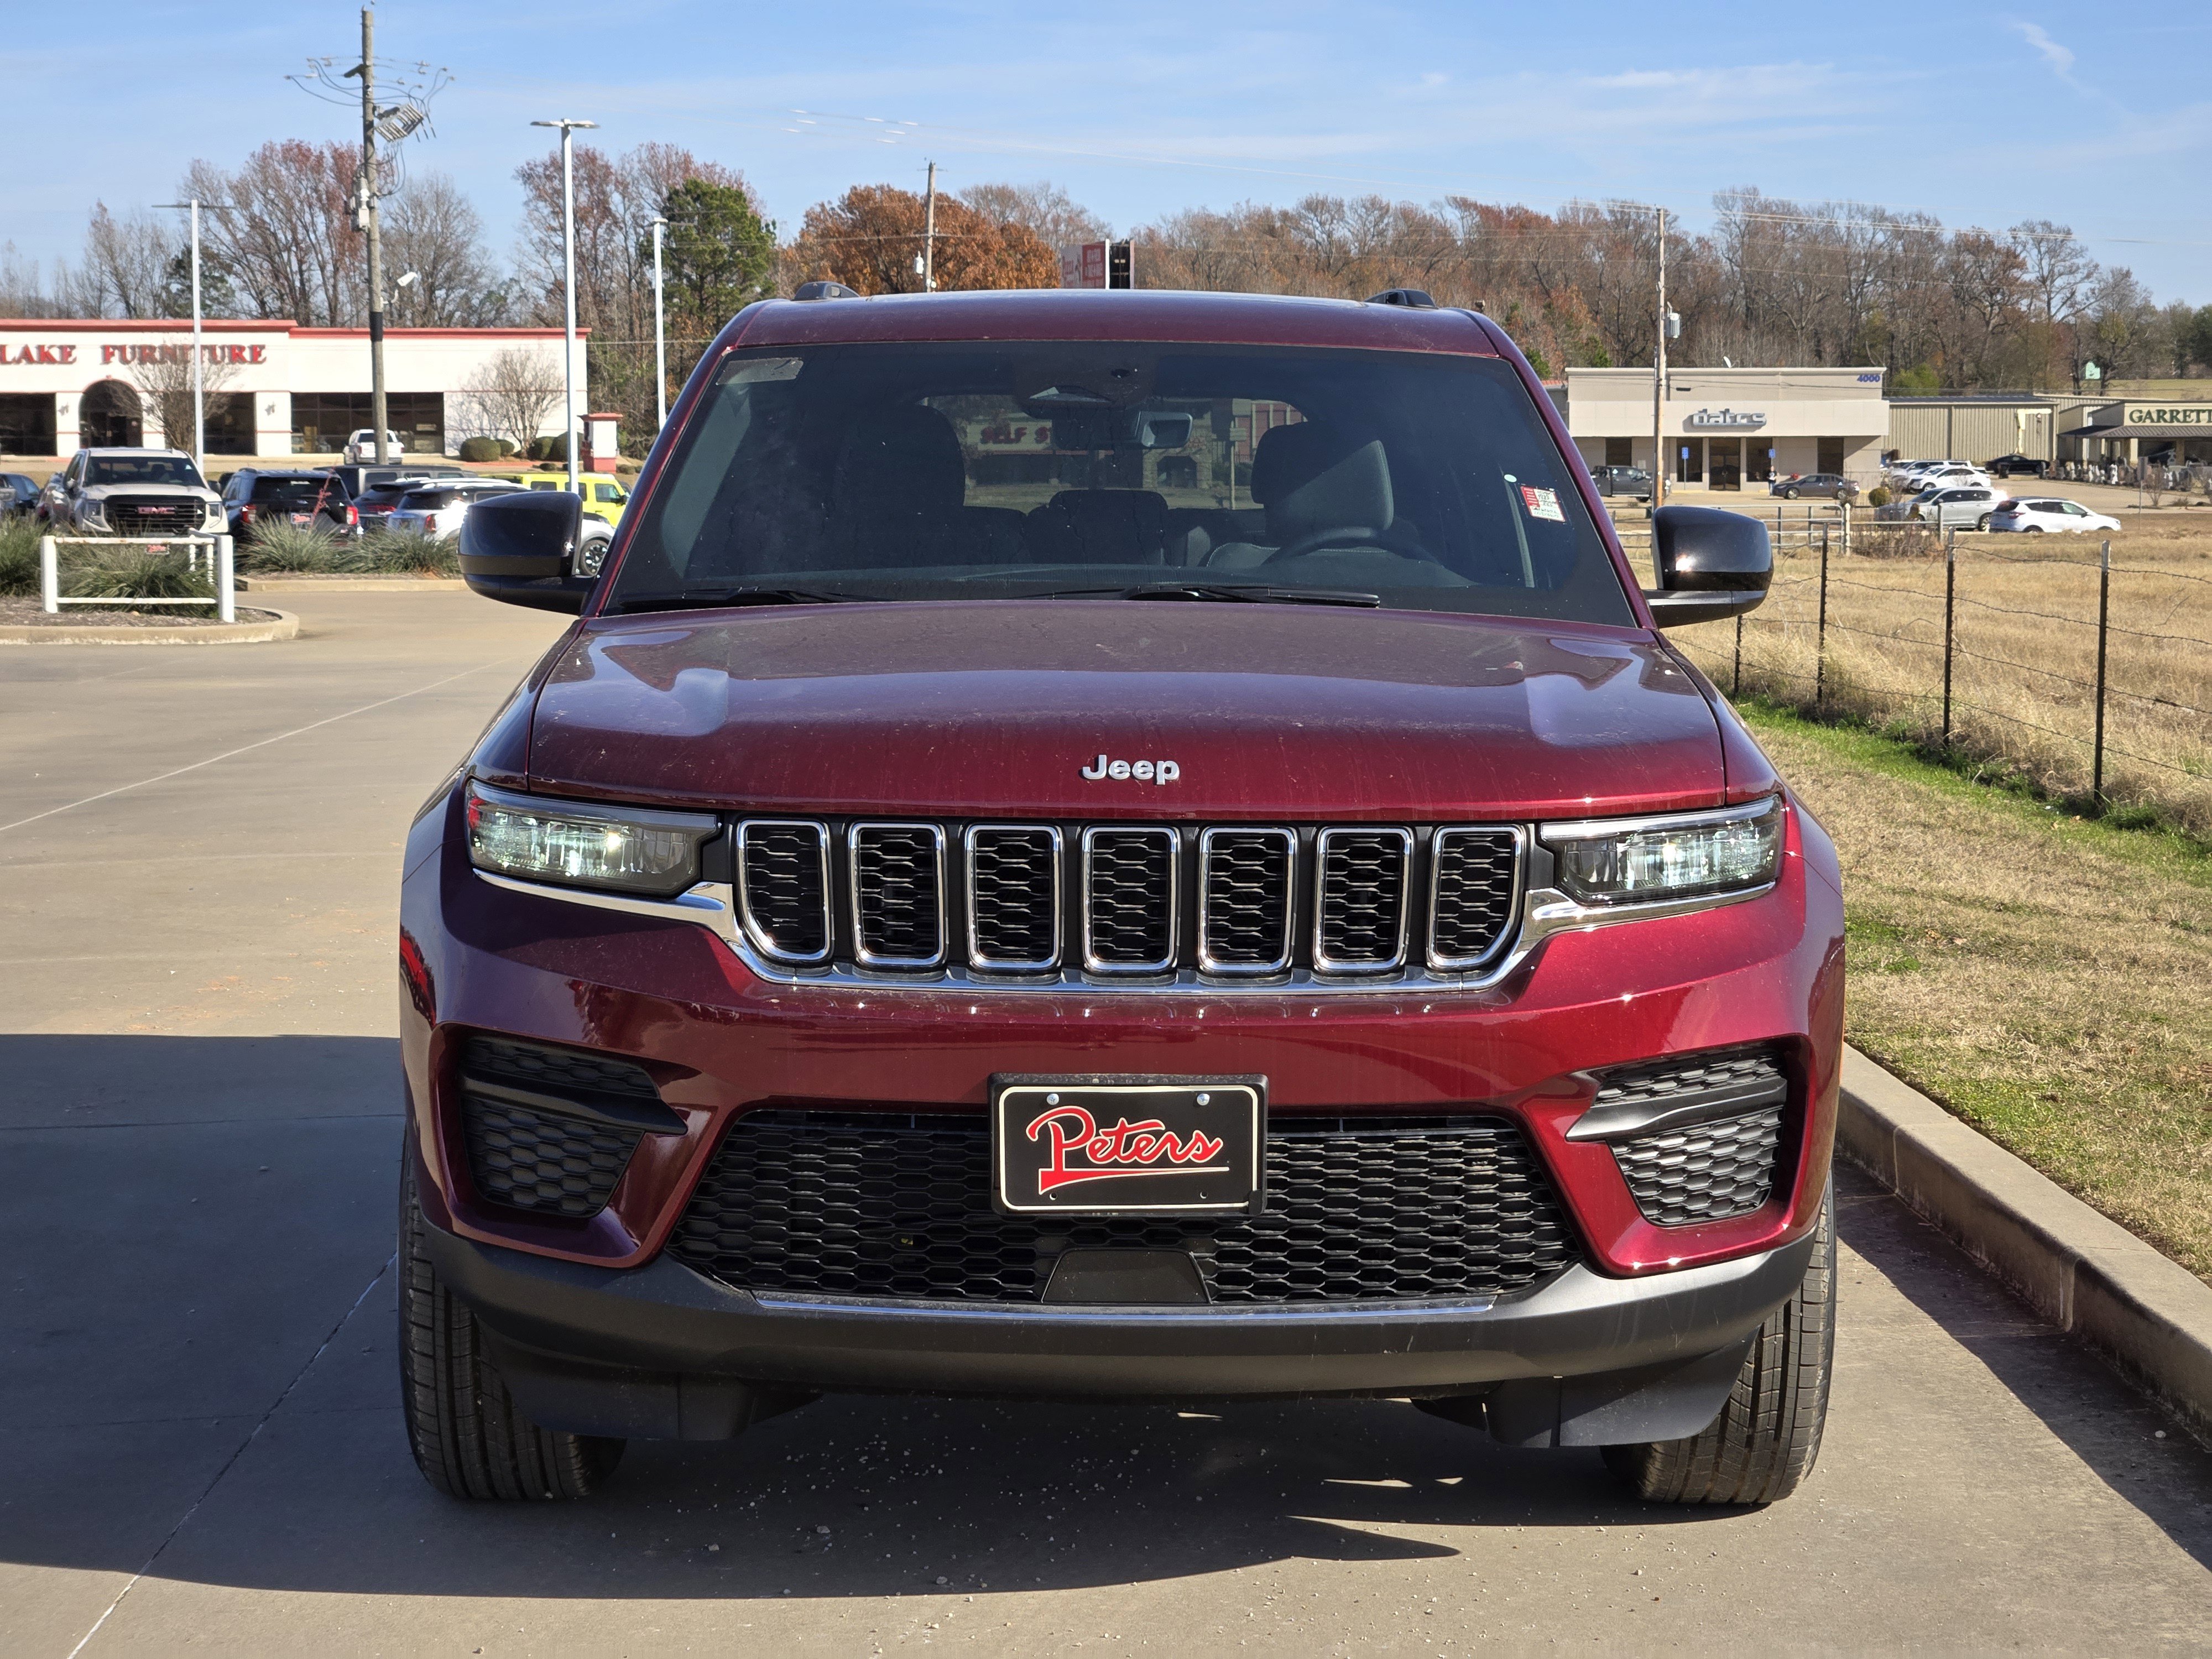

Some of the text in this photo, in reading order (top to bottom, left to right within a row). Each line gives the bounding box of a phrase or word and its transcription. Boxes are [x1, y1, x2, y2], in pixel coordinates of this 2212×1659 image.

[0, 344, 77, 365] LAKE
[1856, 374, 1880, 382] 4000
[1082, 754, 1180, 785] Jeep
[1026, 1105, 1227, 1181] Peters
